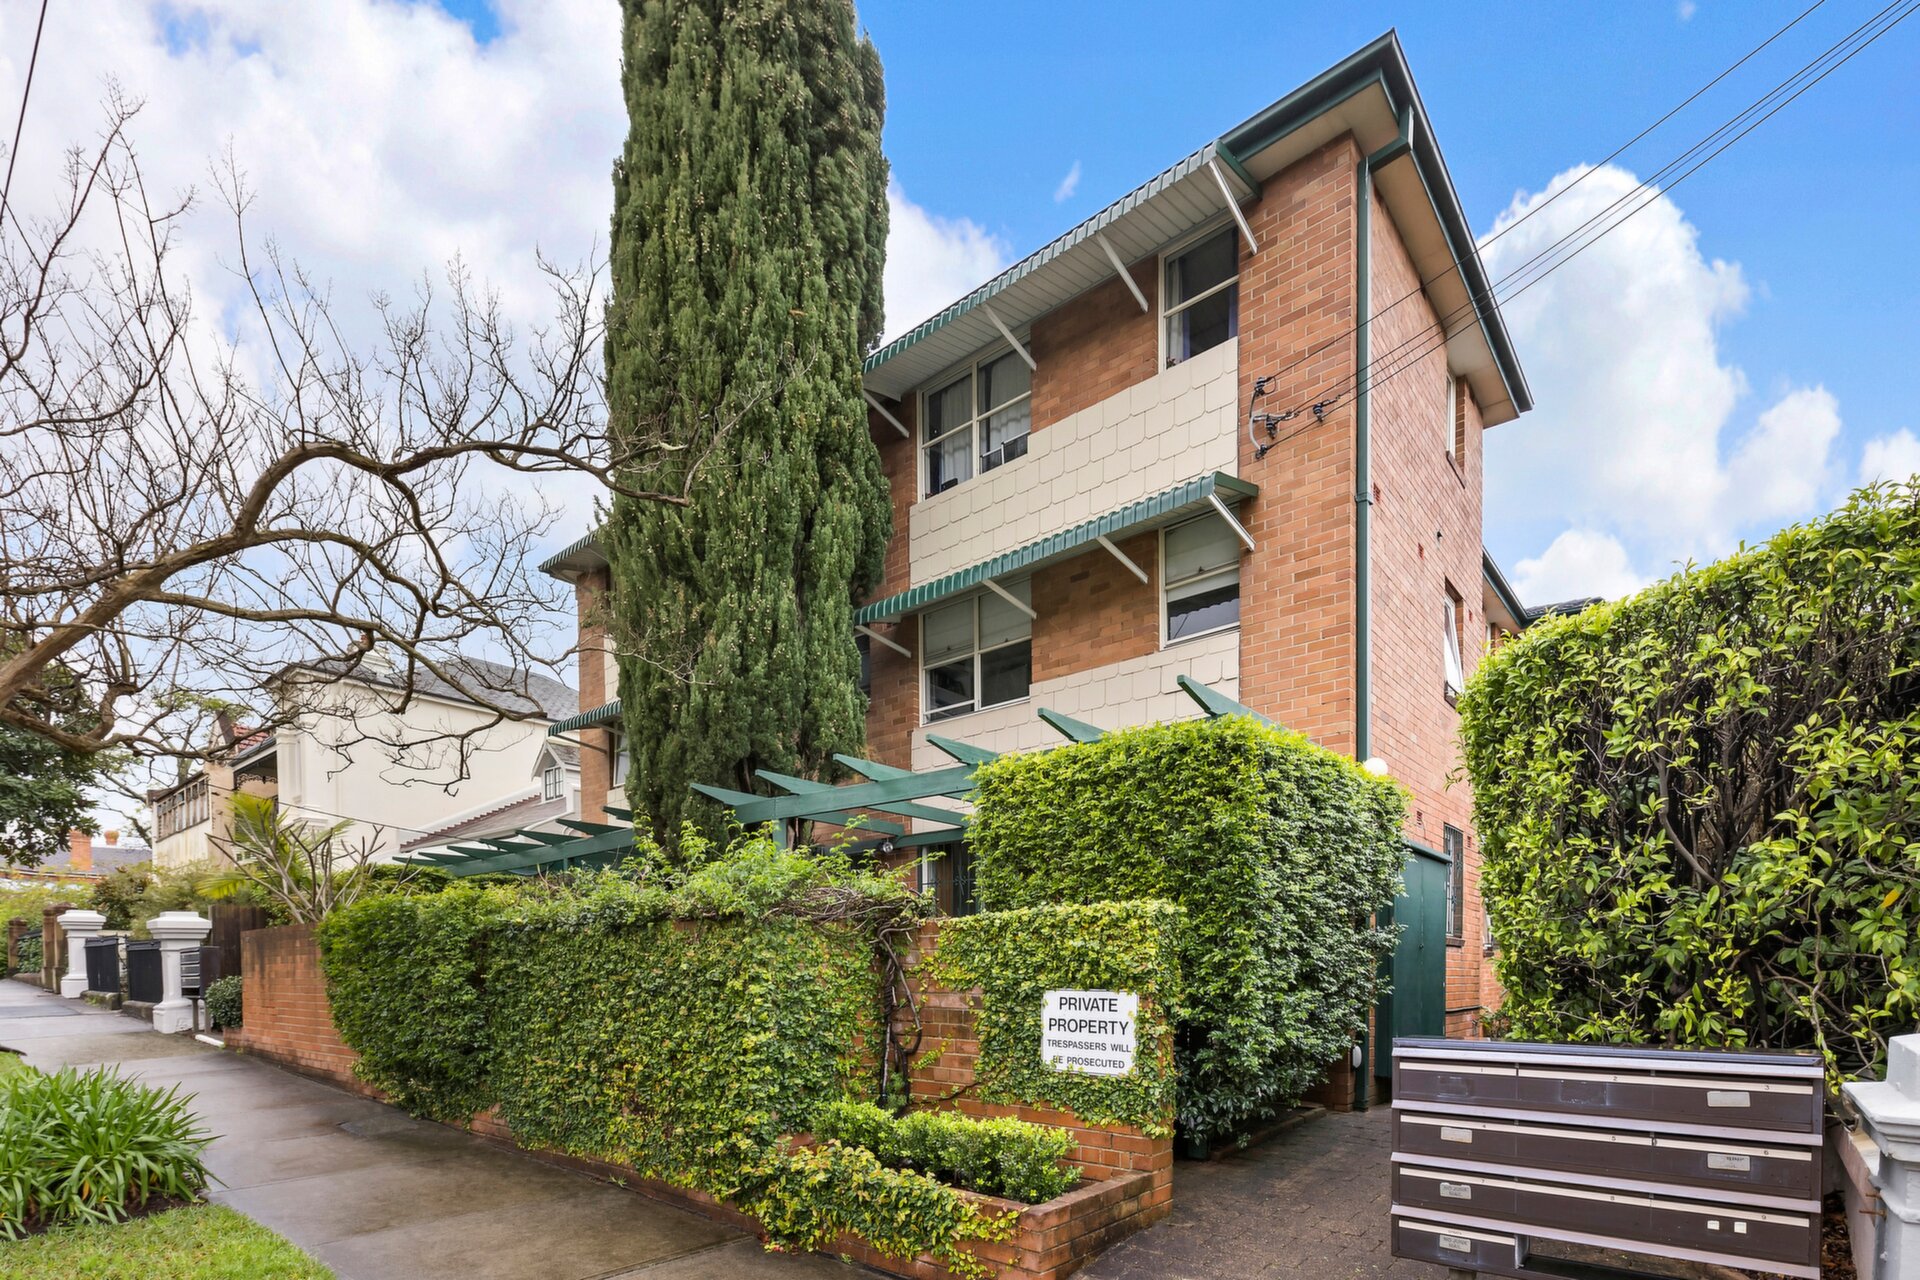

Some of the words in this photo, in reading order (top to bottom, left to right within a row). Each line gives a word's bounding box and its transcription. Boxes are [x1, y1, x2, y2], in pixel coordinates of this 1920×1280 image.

[1059, 997, 1118, 1012] PRIVATE
[1049, 1018, 1129, 1035] PROPERTY
[1047, 1039, 1107, 1051] TRESPASSERS
[1110, 1043, 1131, 1053] WILL
[1053, 1055, 1063, 1064] BE
[1067, 1056, 1125, 1069] PROSECUTED
